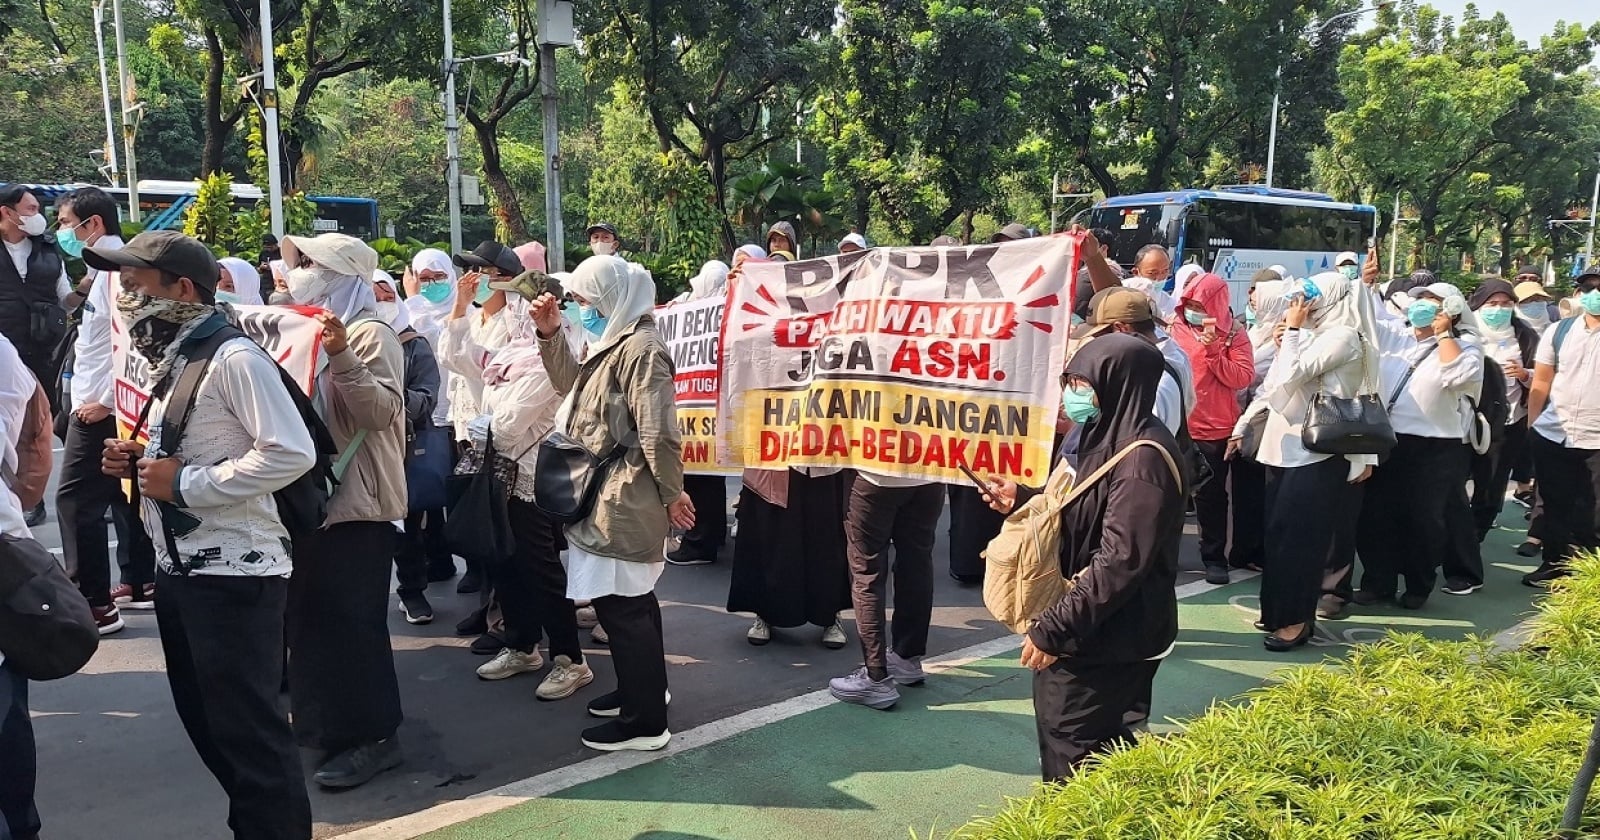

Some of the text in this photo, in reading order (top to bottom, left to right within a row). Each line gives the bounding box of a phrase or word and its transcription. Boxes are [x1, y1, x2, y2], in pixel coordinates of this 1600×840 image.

[788, 303, 1001, 344] PAUH WAKTU
[788, 336, 1006, 382] JGA ASN.
[805, 387, 882, 423] KAMI
[893, 394, 1030, 437] JANGAN
[760, 423, 1033, 478] DIEDA-BEDAKAN.
